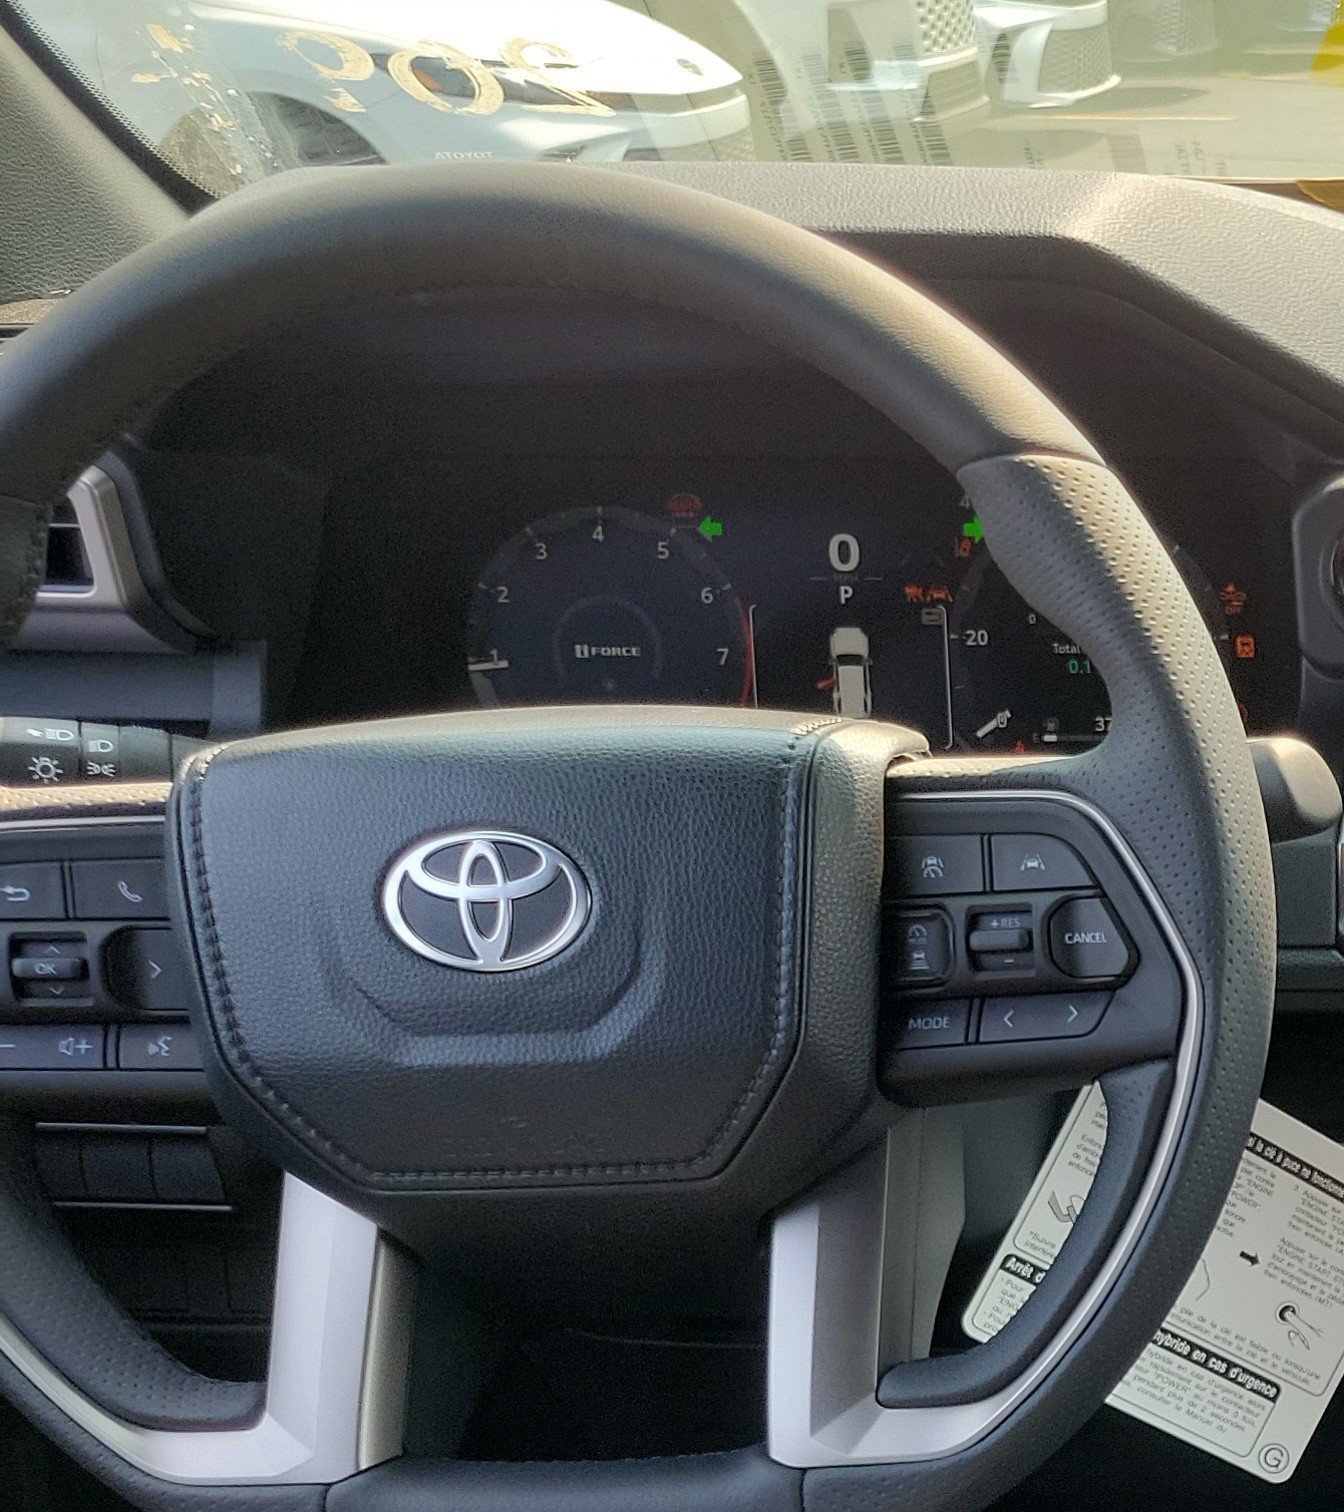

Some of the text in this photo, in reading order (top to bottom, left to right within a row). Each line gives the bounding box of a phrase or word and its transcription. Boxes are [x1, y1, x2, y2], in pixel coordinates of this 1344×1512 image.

[593, 526, 605, 542] 4
[536, 542, 549, 560] 3
[657, 541, 671, 560] 5
[828, 533, 860, 572] 0
[496, 586, 510, 604] 2
[701, 587, 713, 604] 6
[840, 585, 853, 605] P
[965, 629, 989, 647] 20
[718, 648, 730, 666] 7
[1065, 931, 1107, 945] CANCEL
[34, 962, 57, 976] OK
[908, 1016, 951, 1030] MODE
[1005, 1254, 1036, 1279] Arrêt
[1190, 1348, 1207, 1363] en
[1206, 1355, 1229, 1374] cas
[1260, 1444, 1286, 1470] G
